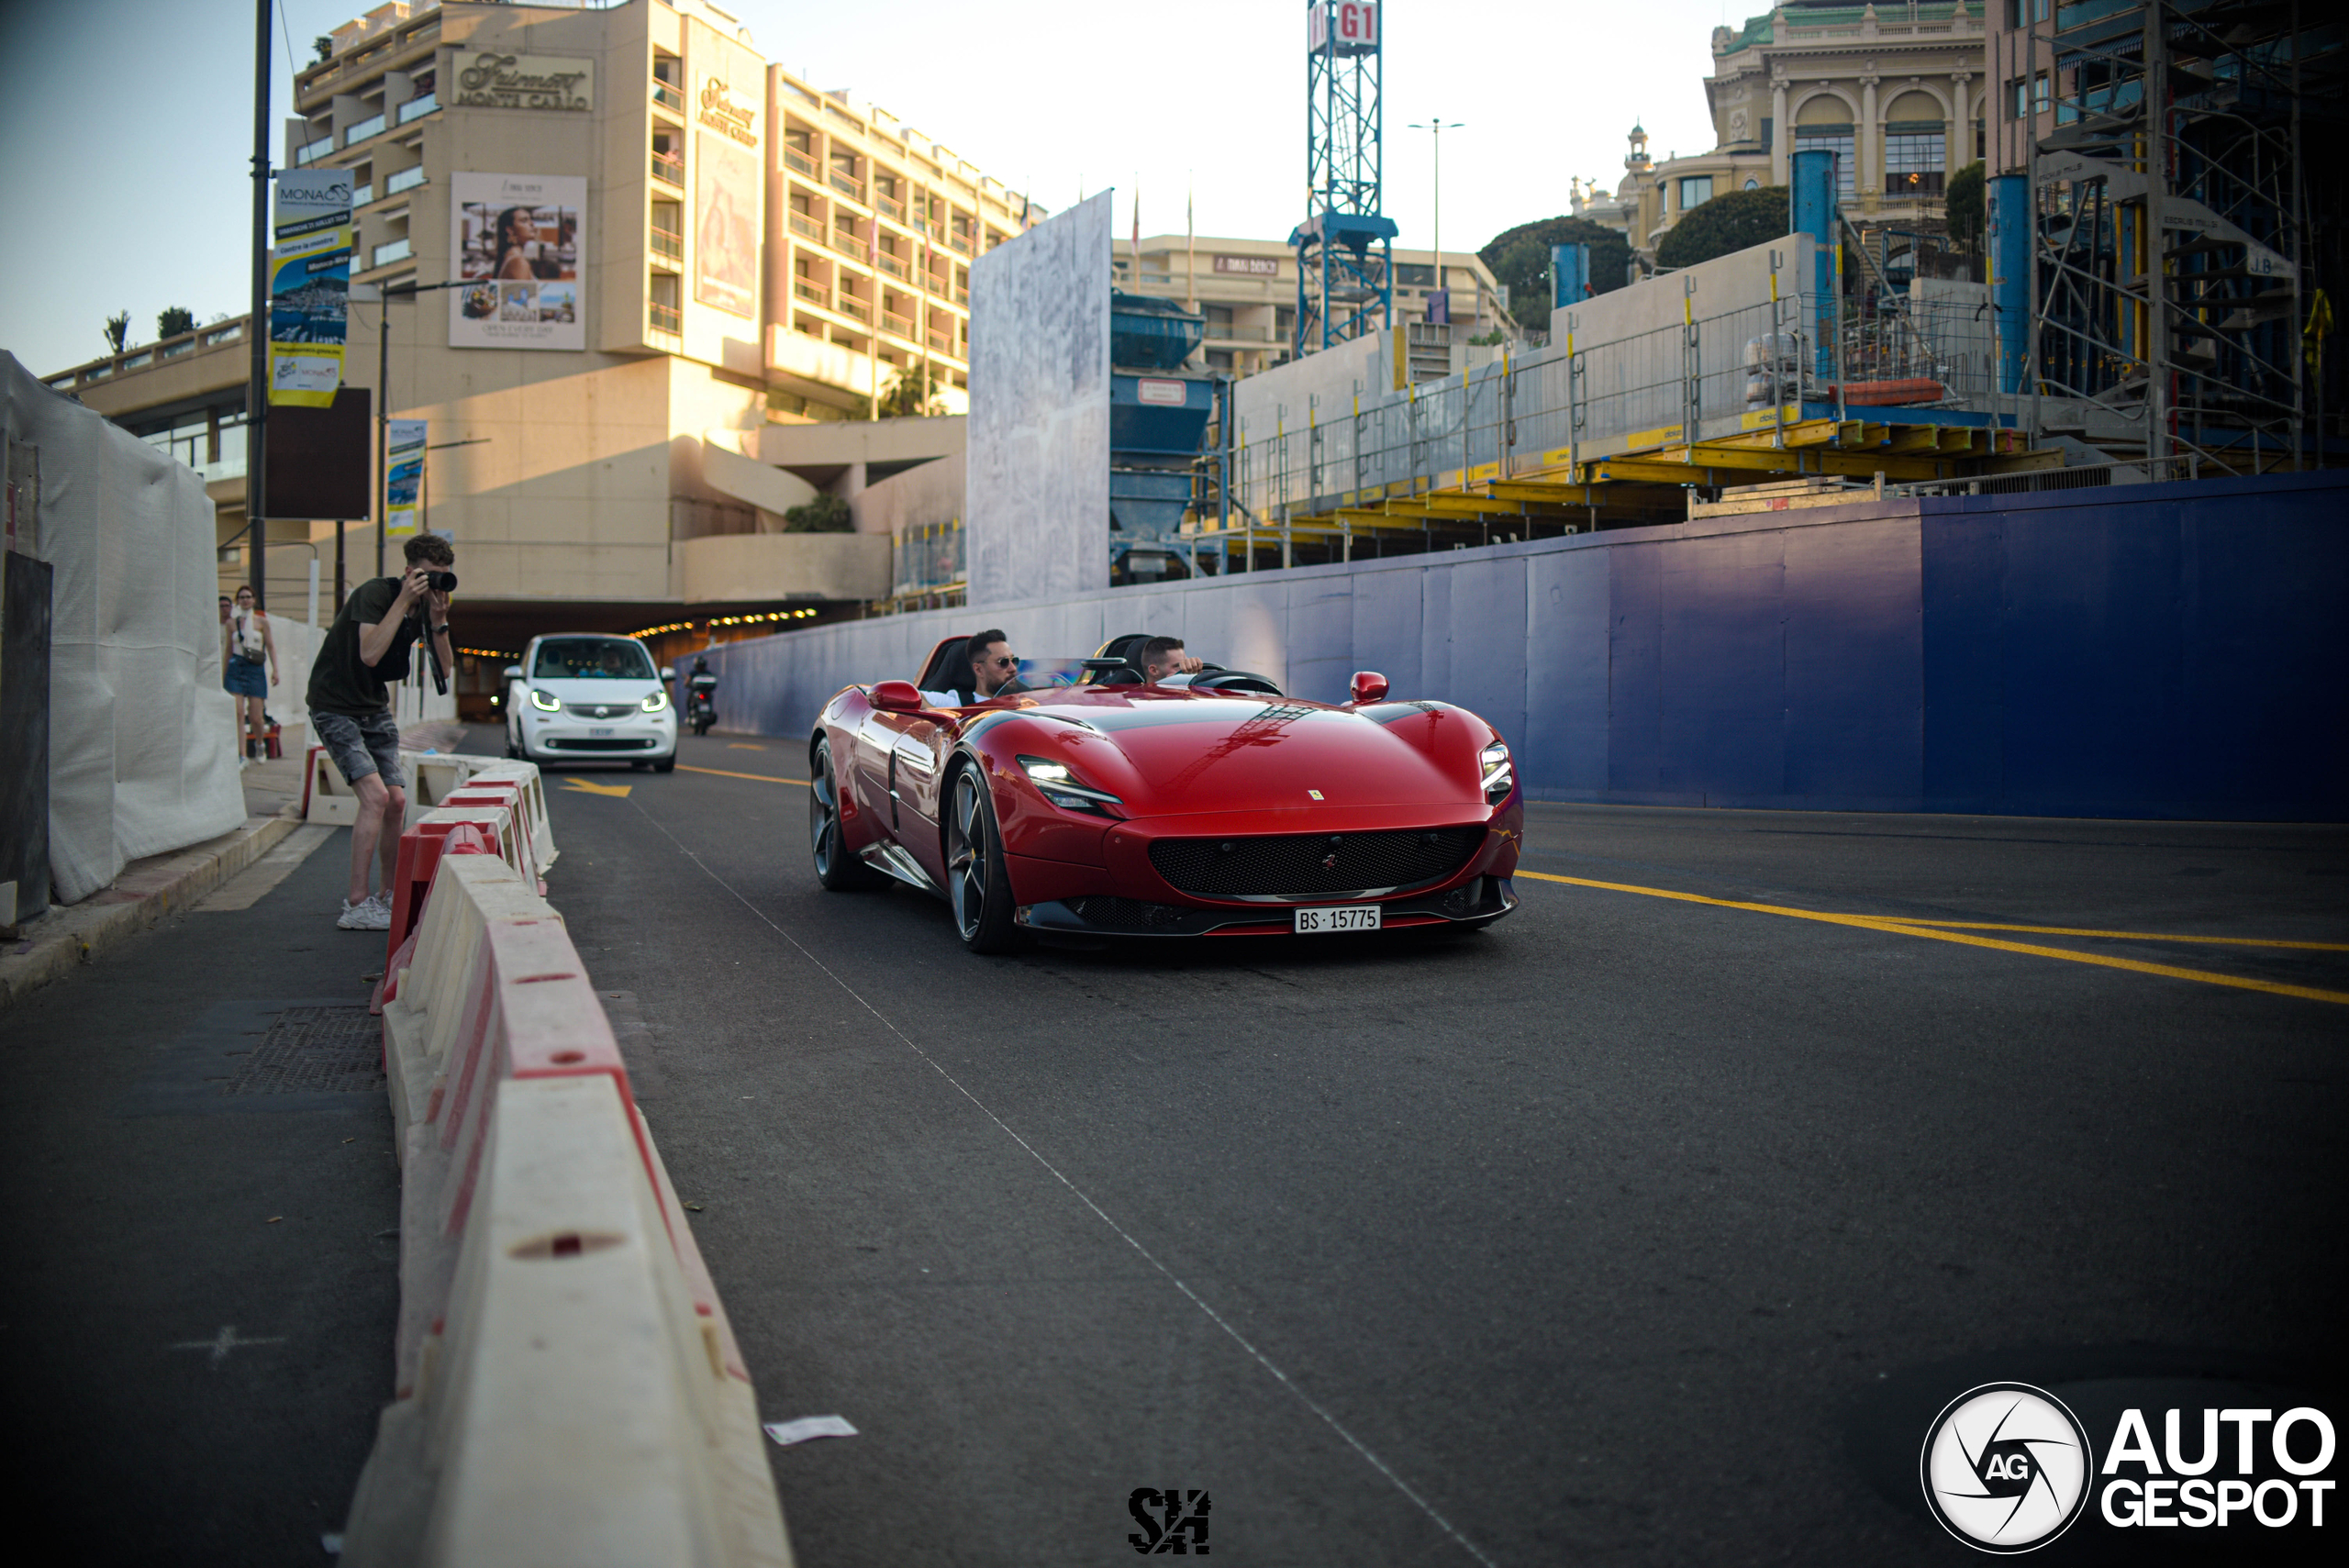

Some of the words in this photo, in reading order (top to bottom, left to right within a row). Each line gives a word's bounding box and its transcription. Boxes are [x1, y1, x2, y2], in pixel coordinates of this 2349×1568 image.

[1341, 3, 1372, 39] G1
[461, 52, 586, 95] Fairmont
[458, 92, 519, 107] MONTE
[529, 95, 586, 111] CARLO
[280, 183, 350, 202] MONACO
[281, 244, 302, 254] Contre
[309, 237, 334, 248] montre
[1300, 912, 1319, 929] BS
[1330, 910, 1375, 929] 15775
